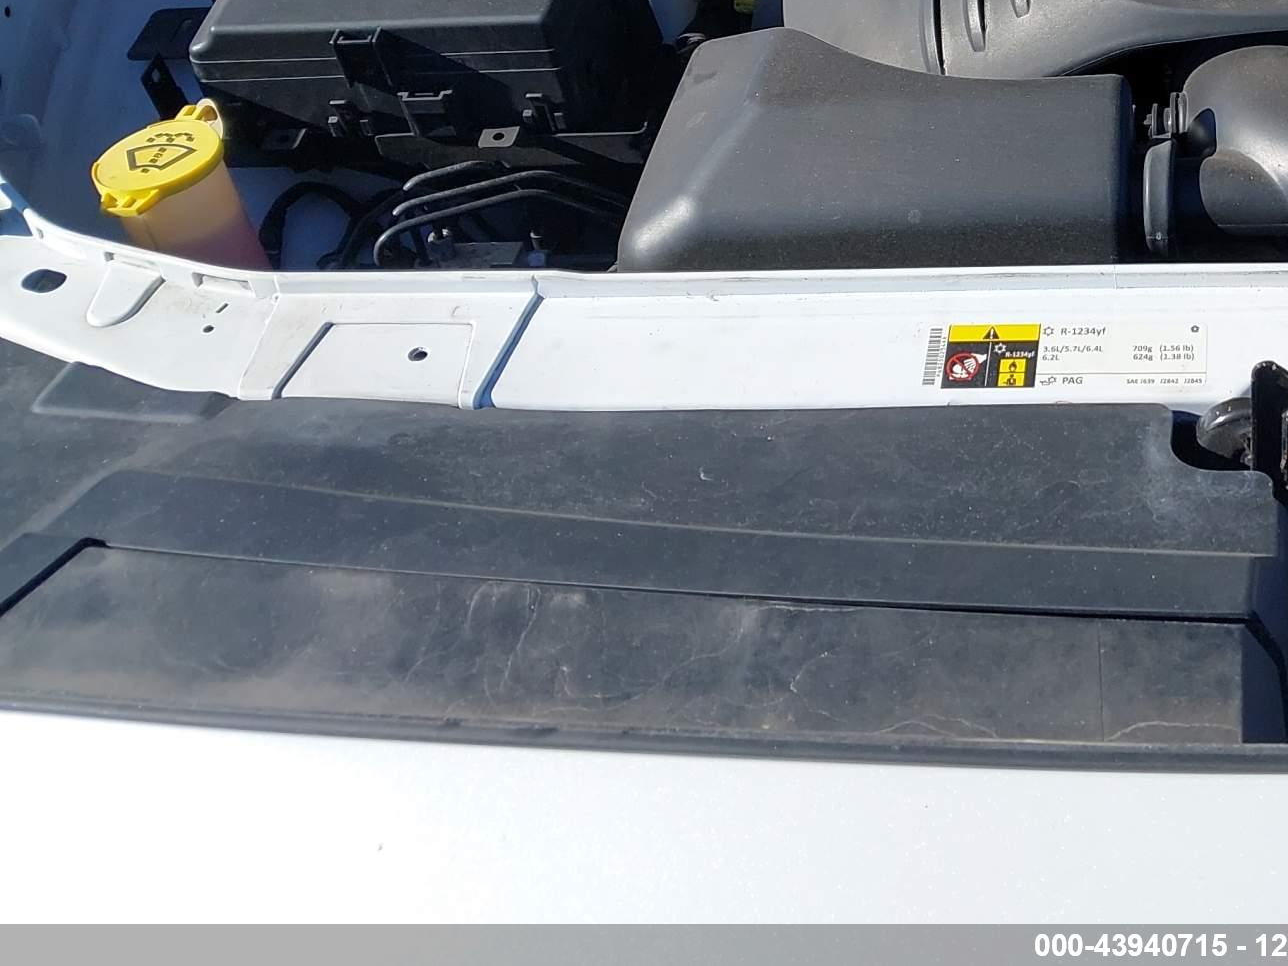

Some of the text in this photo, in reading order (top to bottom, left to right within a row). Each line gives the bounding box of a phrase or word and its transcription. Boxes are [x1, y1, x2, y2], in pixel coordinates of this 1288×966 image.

[1060, 327, 1106, 337] R-1234yf
[1043, 345, 1103, 353] 3.6L/5.7L/6.4L
[1159, 344, 1181, 353] (1.56
[1182, 344, 1194, 353] lb)
[1005, 351, 1035, 359] R-1234yf
[1183, 353, 1195, 361] lb)
[1062, 376, 1083, 385] PAG
